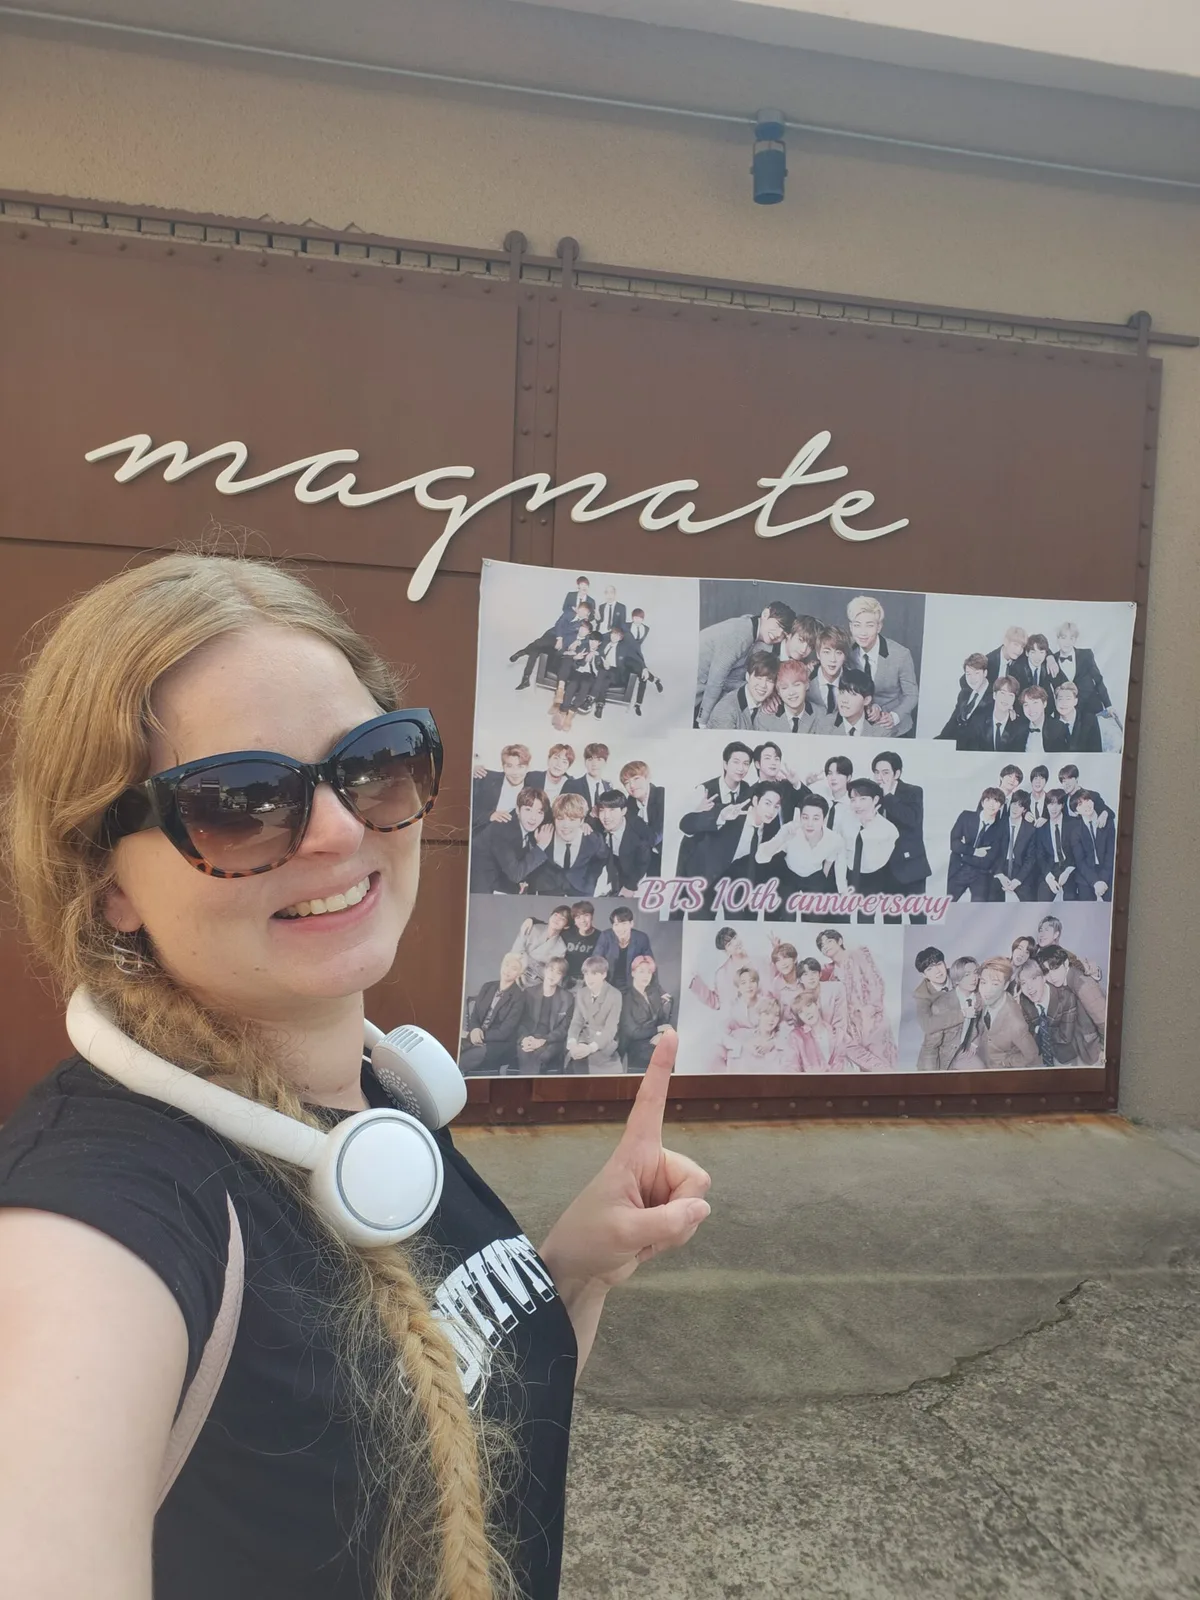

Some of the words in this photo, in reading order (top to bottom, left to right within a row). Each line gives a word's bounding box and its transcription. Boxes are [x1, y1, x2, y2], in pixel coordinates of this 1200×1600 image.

[84, 429, 910, 602] magnate
[639, 878, 706, 911] BTS
[712, 877, 781, 911] 10th
[786, 887, 953, 921] anniversary
